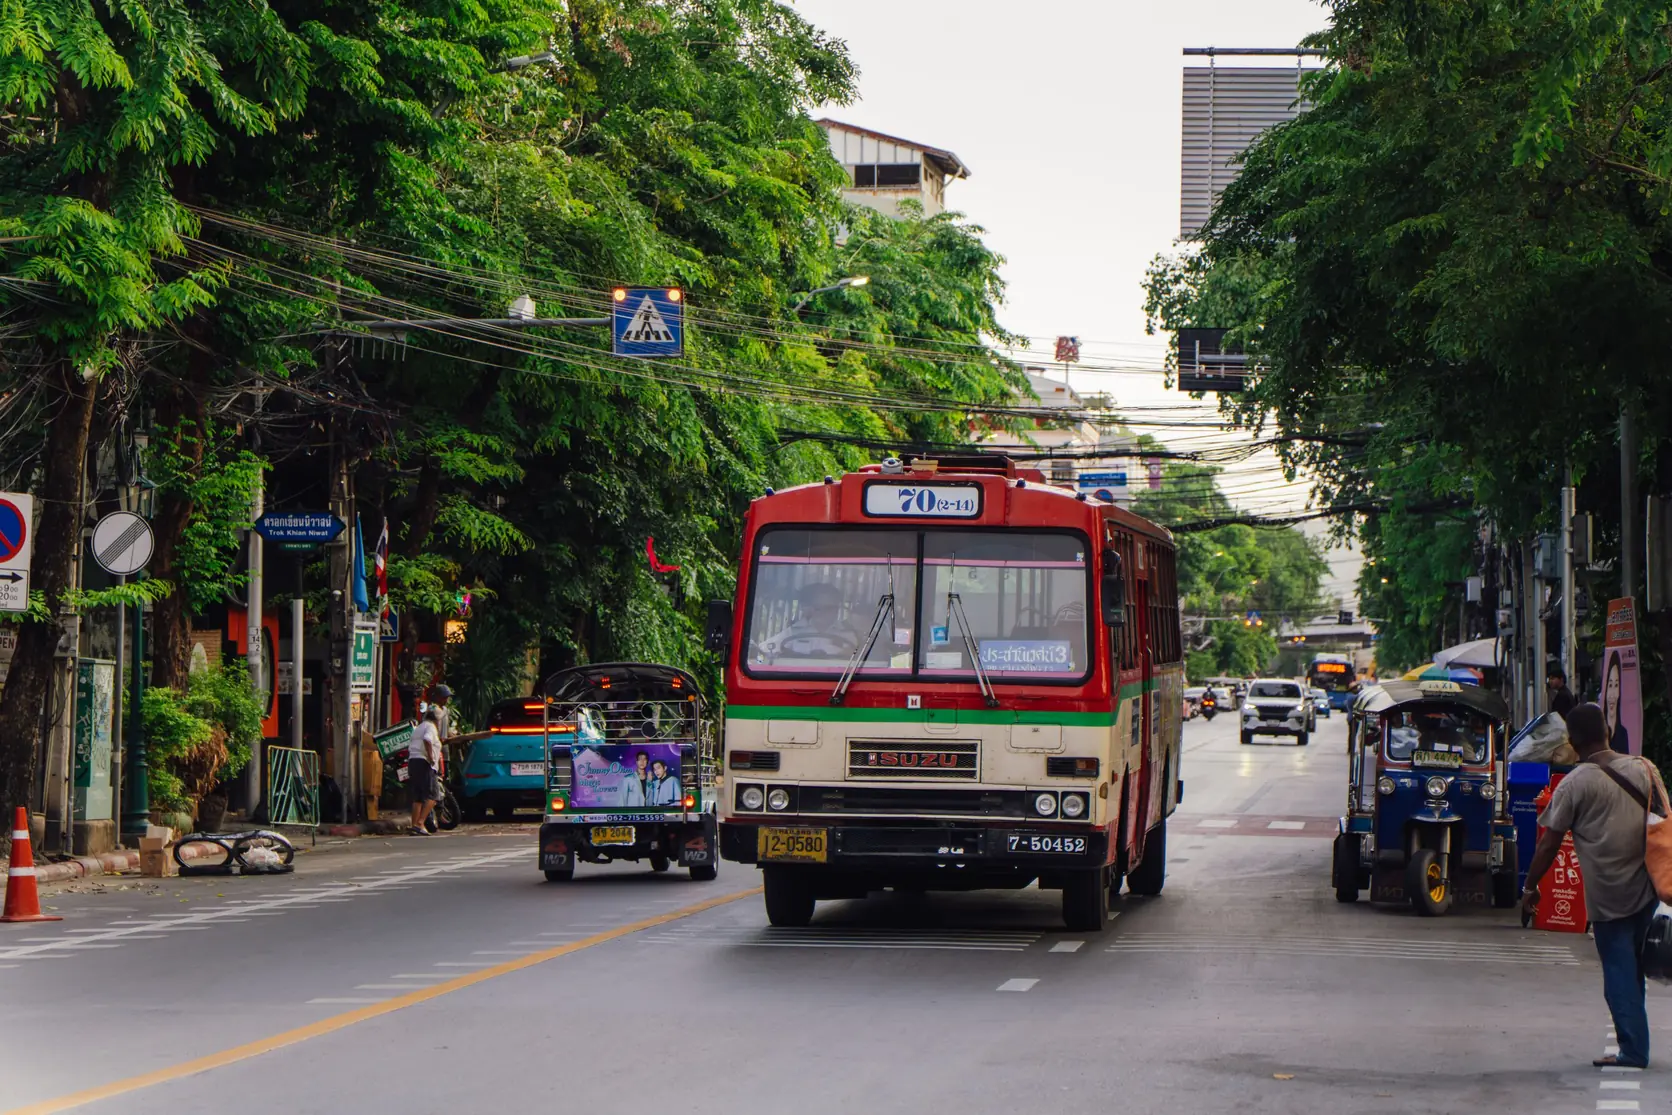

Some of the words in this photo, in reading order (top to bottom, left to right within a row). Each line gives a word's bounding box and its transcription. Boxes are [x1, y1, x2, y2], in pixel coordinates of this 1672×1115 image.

[898, 488, 936, 512] 70
[936, 498, 974, 512] (2-14)
[1055, 646, 1067, 663] 3
[868, 752, 958, 768] ISUZU
[1009, 835, 1085, 853] 7-50452
[684, 850, 708, 862] WD
